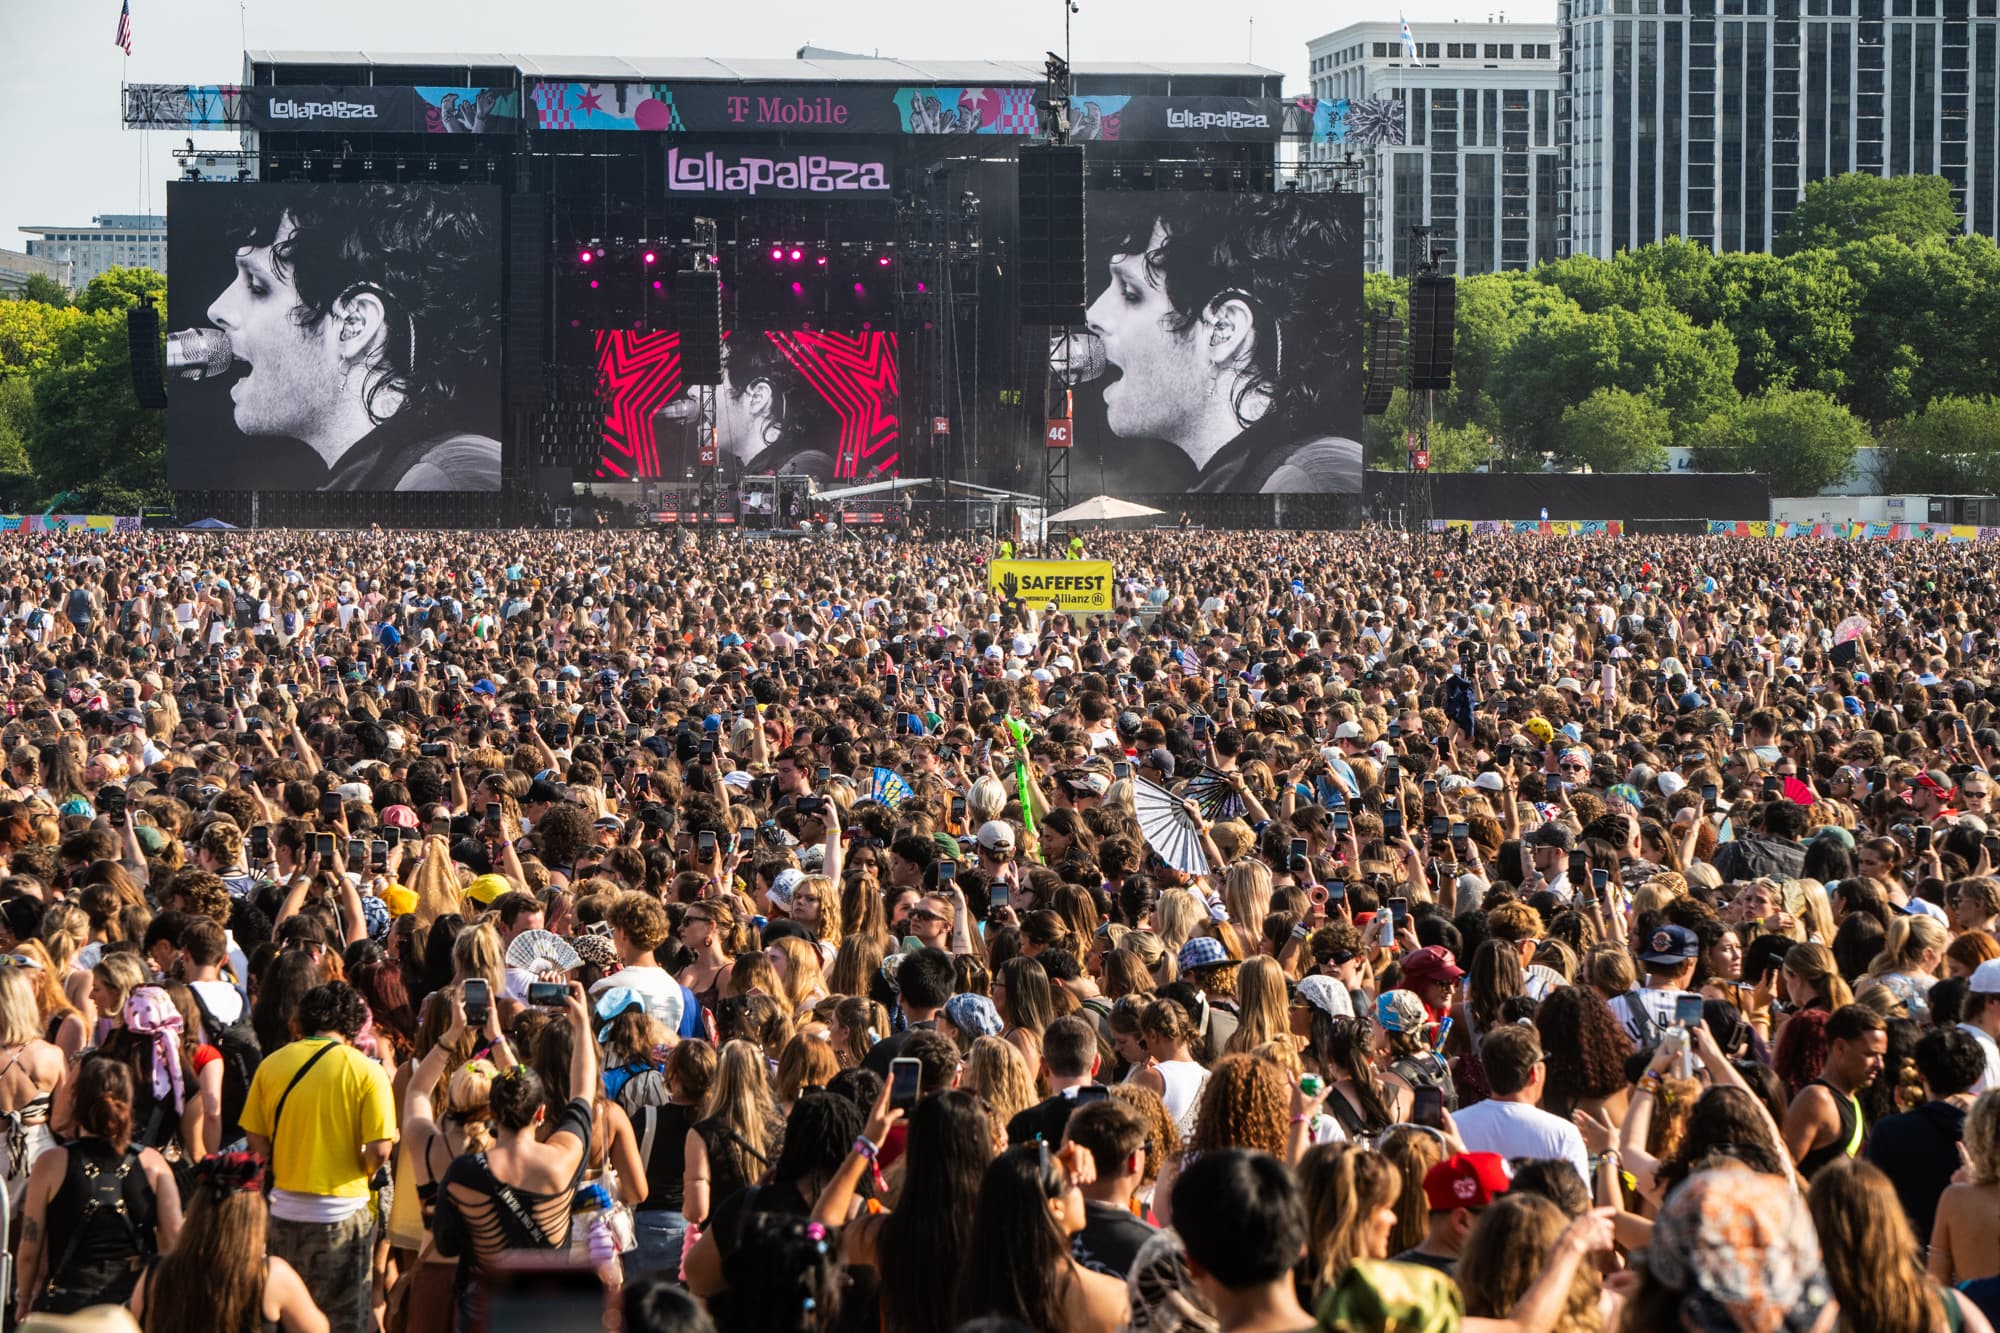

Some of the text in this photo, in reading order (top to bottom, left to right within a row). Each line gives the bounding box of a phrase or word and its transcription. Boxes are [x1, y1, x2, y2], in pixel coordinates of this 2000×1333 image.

[269, 97, 379, 120] Lollapalooza
[756, 96, 848, 124] Mobile
[1166, 107, 1271, 130] Lollapalooza
[668, 147, 891, 195] Lollapalooza
[1048, 426, 1067, 441] 4C
[701, 451, 713, 461] 2C
[1021, 575, 1105, 591] SAFEFEST
[1055, 594, 1090, 604] Allianz
